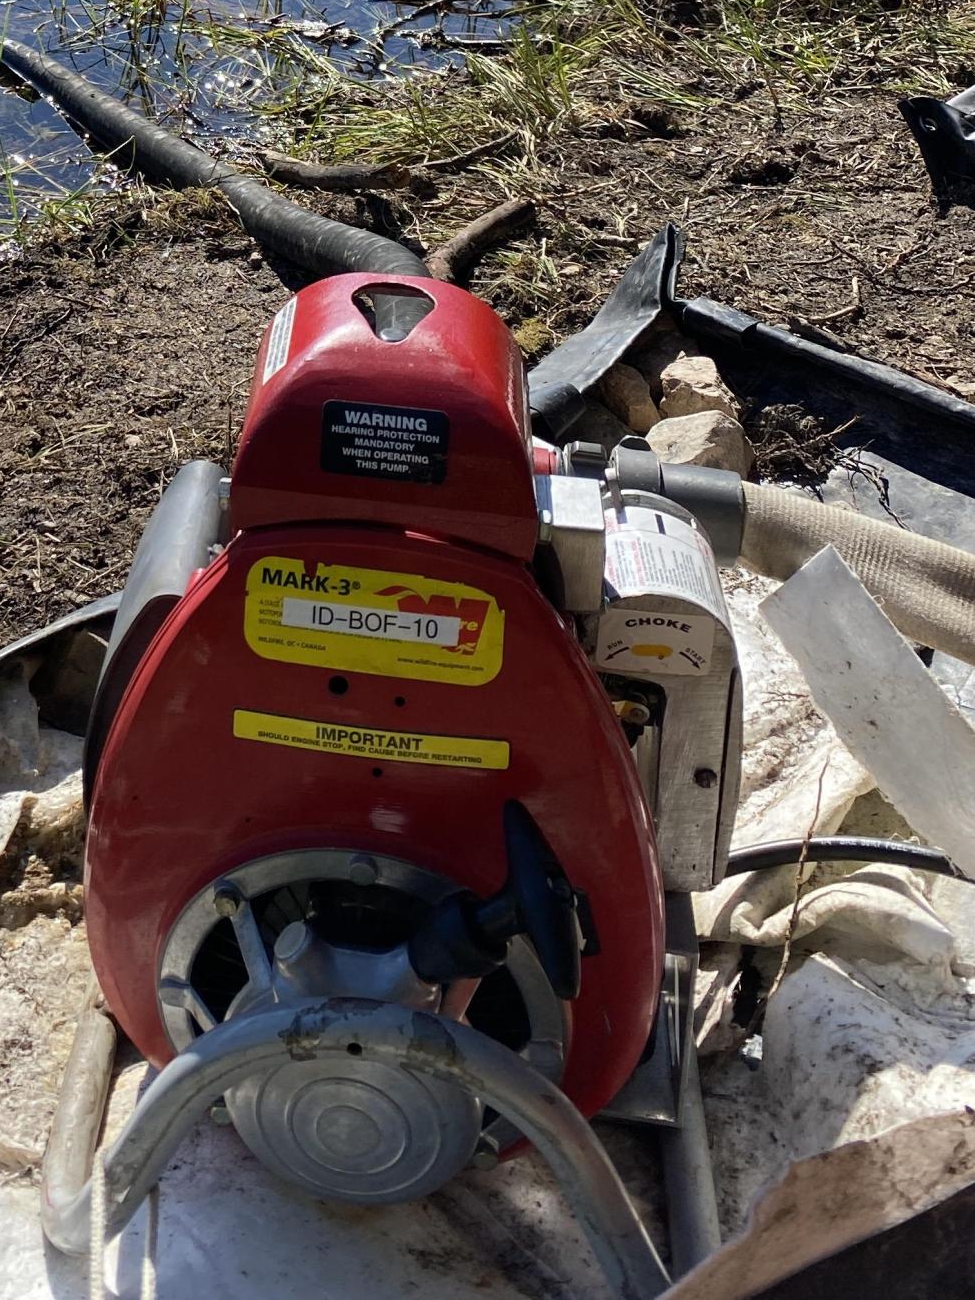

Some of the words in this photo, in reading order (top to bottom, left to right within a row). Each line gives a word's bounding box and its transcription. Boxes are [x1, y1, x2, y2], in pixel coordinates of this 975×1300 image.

[345, 410, 428, 431] WARNING
[331, 424, 375, 436] HEARING
[377, 429, 440, 444] PROTECTION
[355, 438, 415, 452] MANDATORY
[342, 447, 371, 458] WHEN
[373, 450, 429, 464] OPERATING
[356, 460, 378, 470] THIS
[312, 605, 438, 639] ID-BOF-10
[625, 617, 692, 633] CHOKE
[607, 640, 623, 650] RUN
[685, 648, 707, 664] START
[257, 730, 290, 741] SHOULD
[291, 736, 321, 747] ENGINE
[322, 741, 346, 751] STOP,
[348, 745, 366, 753] FIND
[368, 747, 395, 756] CAUSE
[397, 751, 429, 760] BEFORE
[431, 754, 482, 764] RESTARTING
[316, 726, 423, 751] IMPORTANT
